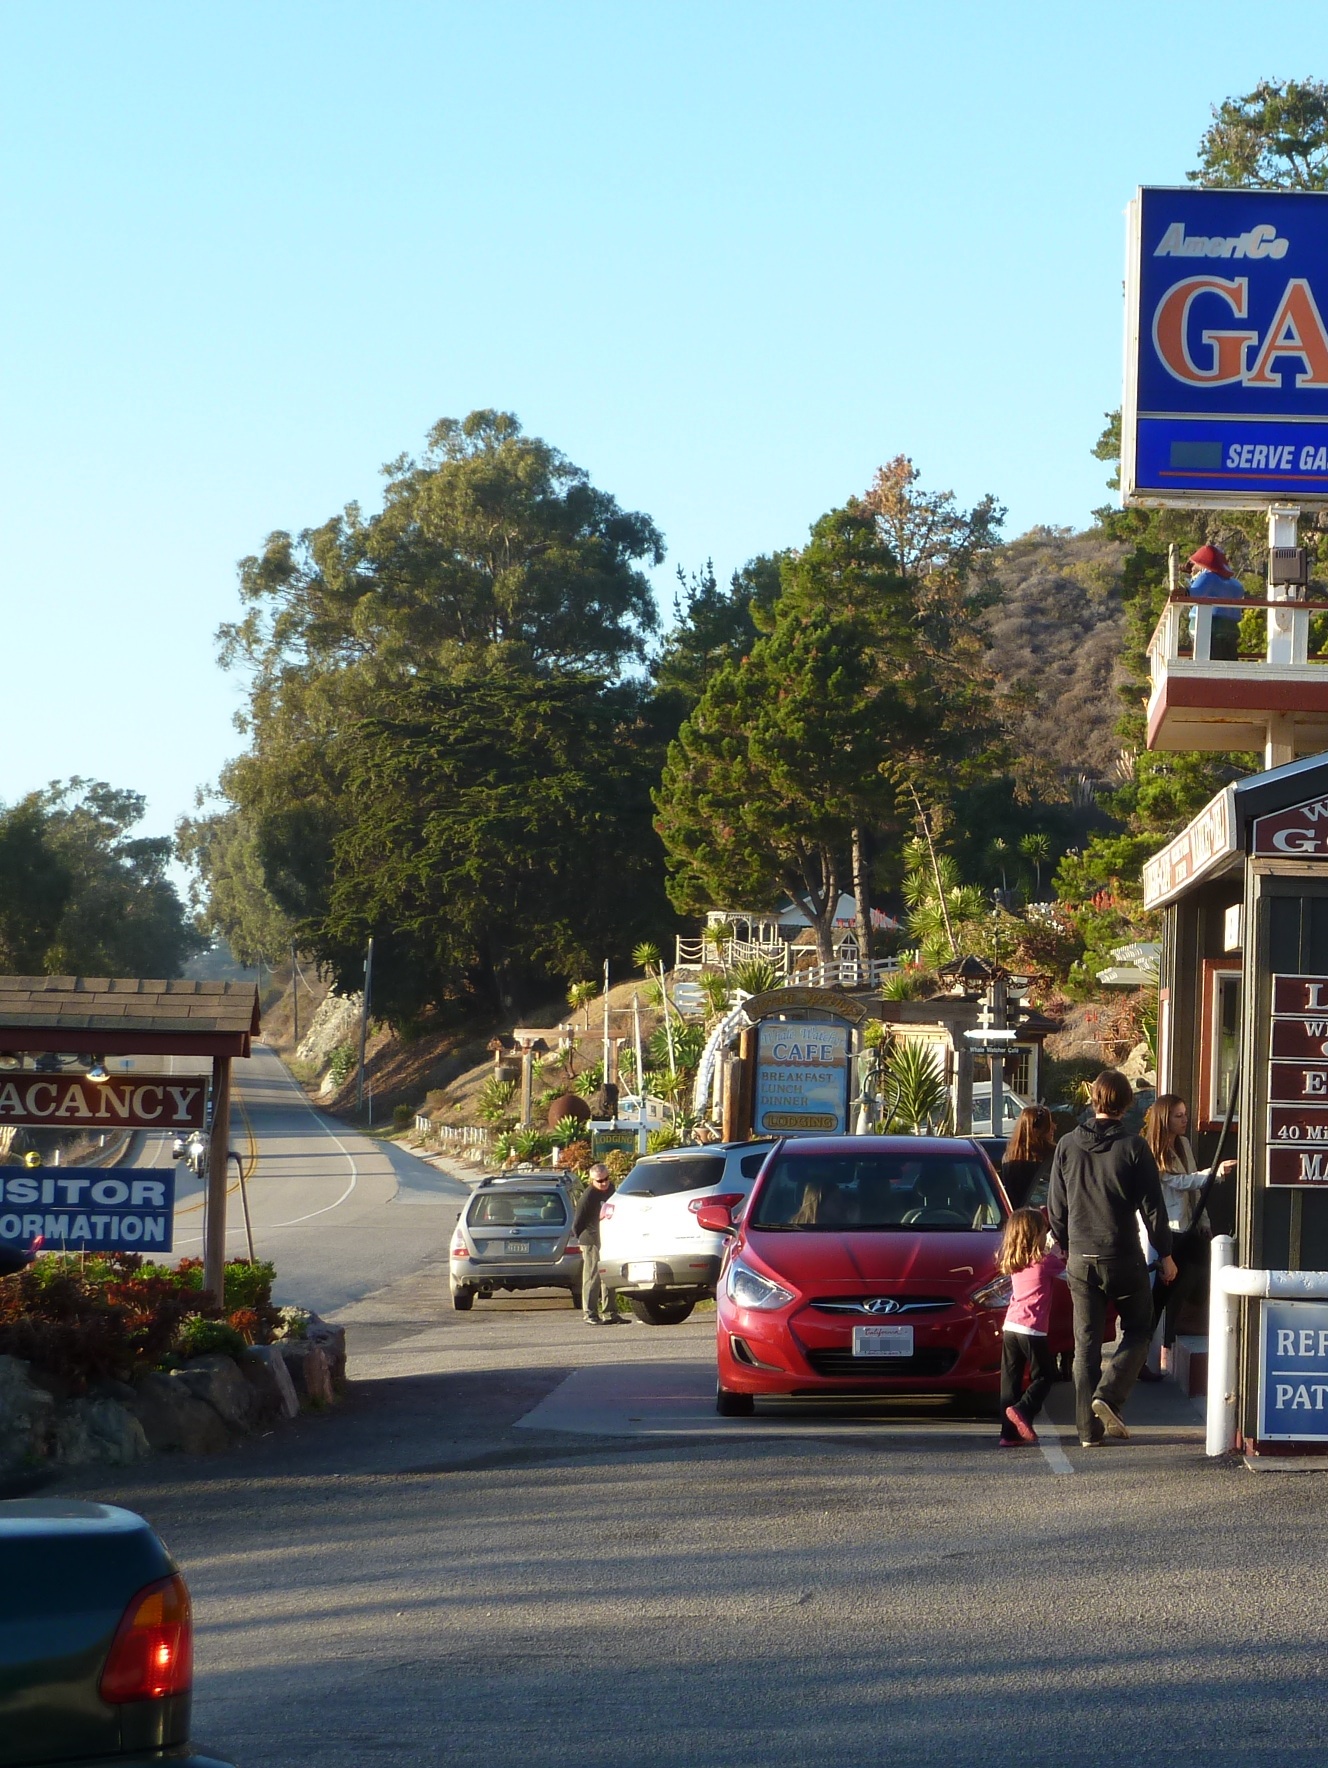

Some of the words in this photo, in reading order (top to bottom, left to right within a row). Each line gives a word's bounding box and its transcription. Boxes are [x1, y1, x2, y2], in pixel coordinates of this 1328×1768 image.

[1153, 222, 1289, 259] AmeriCo
[1226, 444, 1295, 470] SERVE
[772, 1043, 834, 1062] CAFE
[761, 1071, 833, 1082] BREAKFAST
[761, 1084, 803, 1094] LUNCH
[0, 1082, 200, 1120] ACANCY
[761, 1096, 808, 1106] DINNER
[768, 1115, 833, 1128] LODGING
[595, 1135, 633, 1145] LODGING
[1277, 1125, 1300, 1140] 40
[0, 1178, 166, 1206] SITOR
[0, 1214, 165, 1242] ORMATION
[865, 1328, 902, 1337] California
